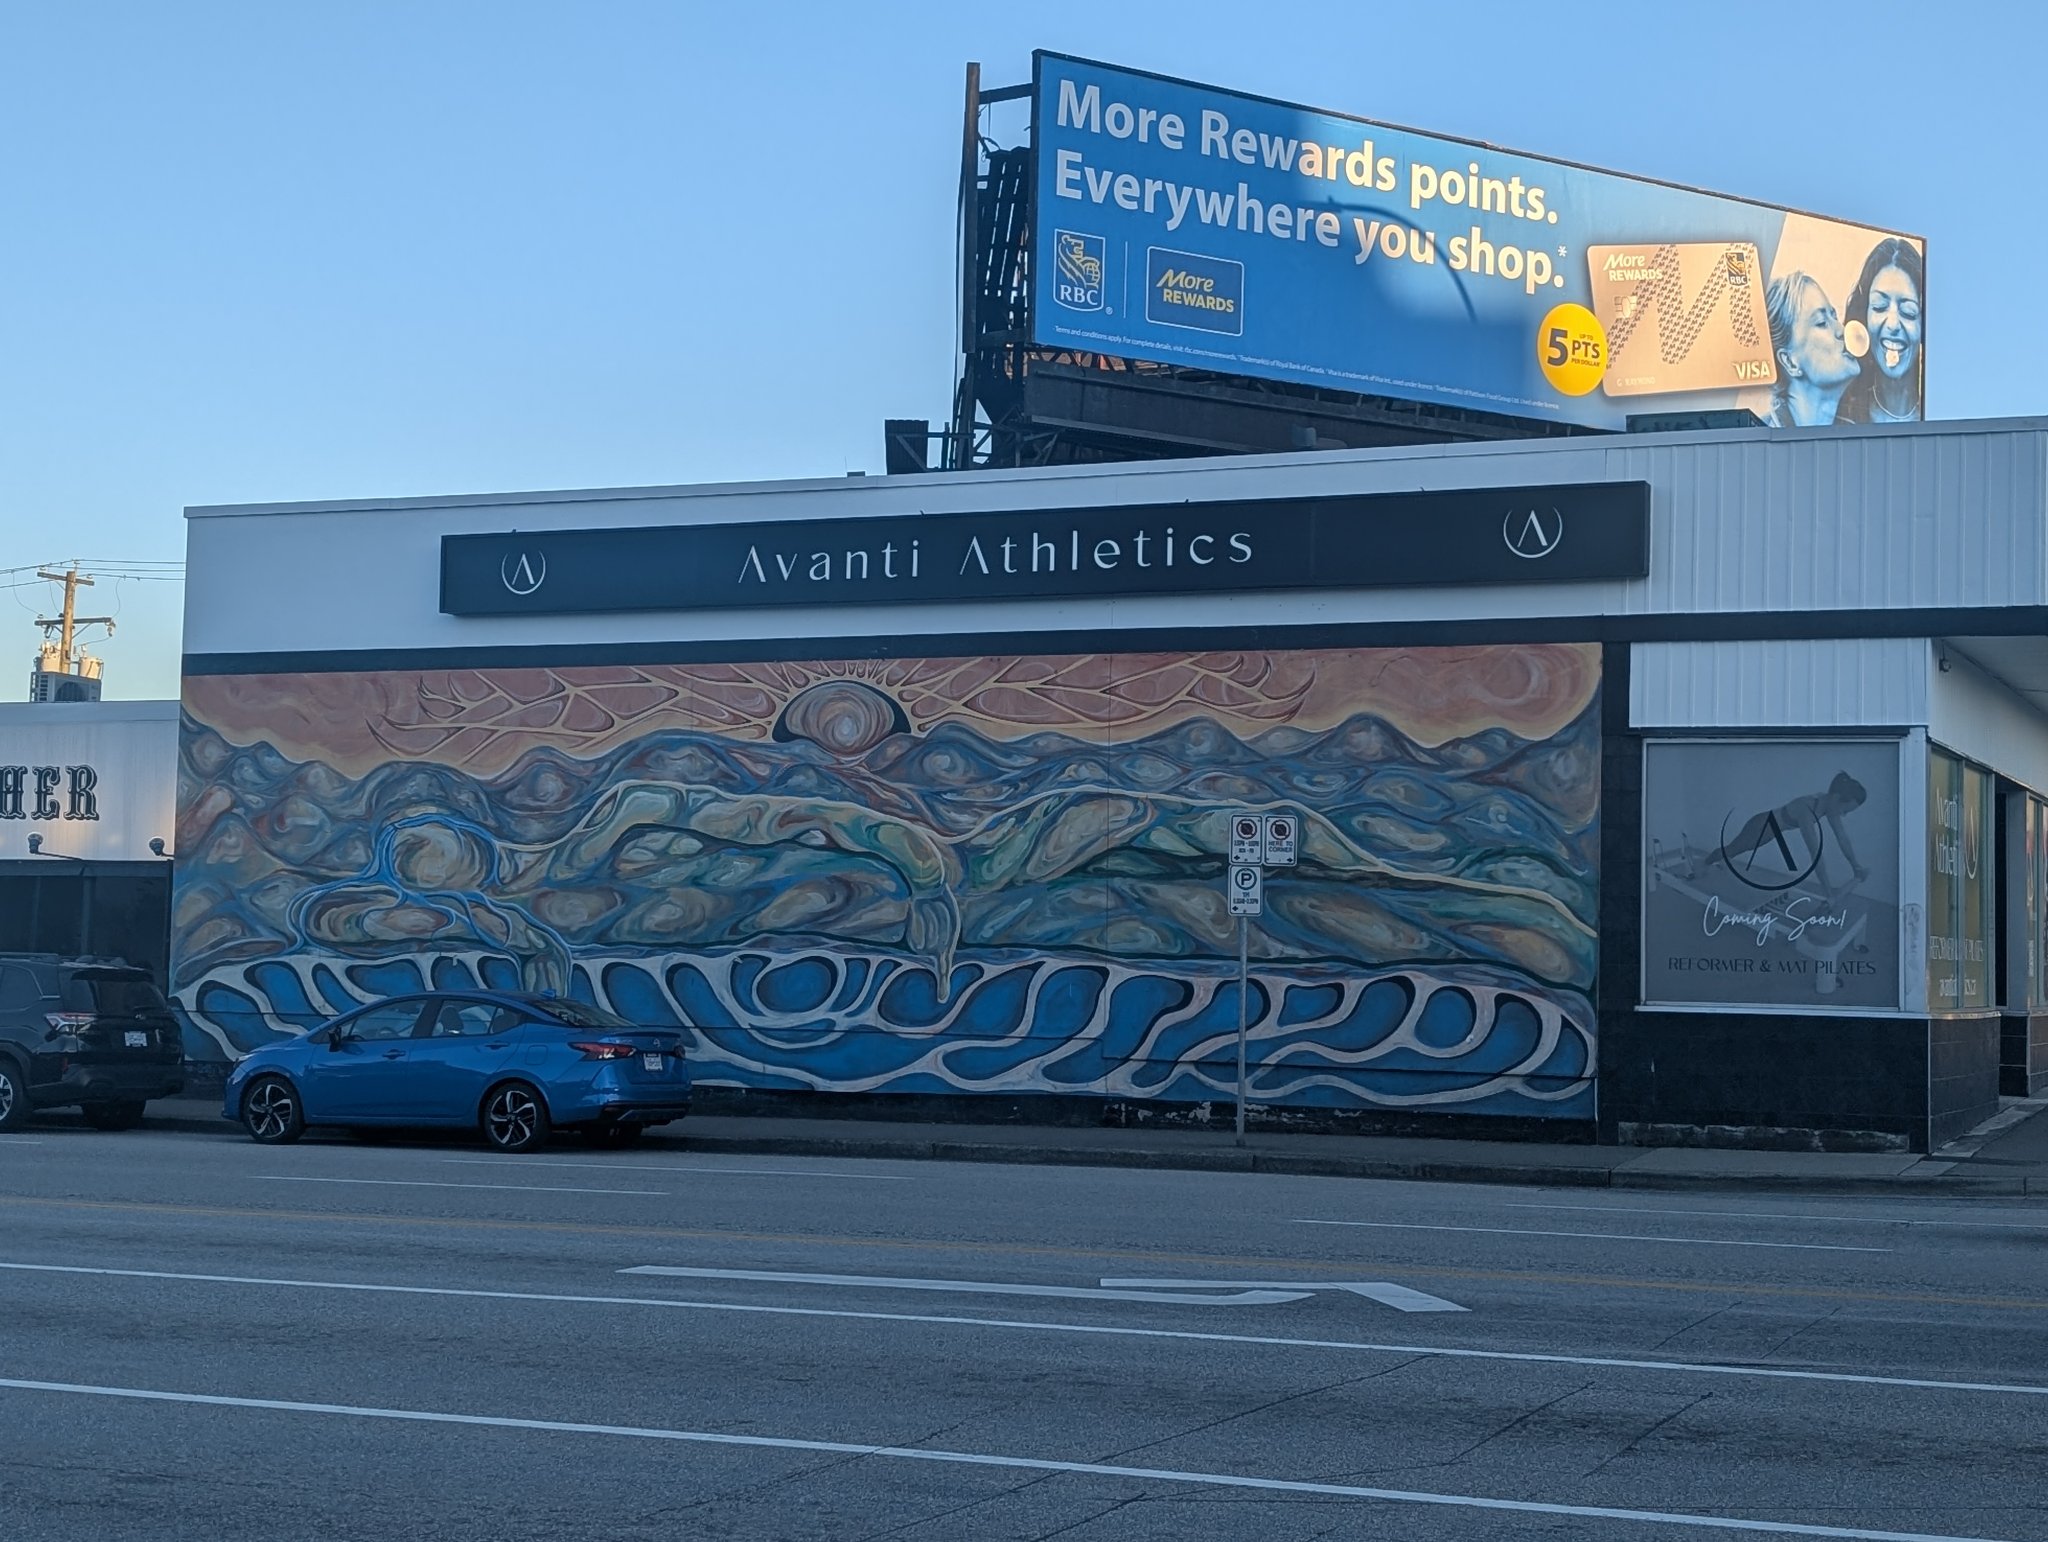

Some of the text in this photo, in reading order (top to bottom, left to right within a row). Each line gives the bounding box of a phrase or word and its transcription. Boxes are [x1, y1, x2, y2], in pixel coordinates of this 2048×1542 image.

[1056, 79, 1558, 225] More Rewards points.
[1055, 149, 1341, 247] Everywhere
[1353, 216, 1435, 266] you
[1603, 253, 1645, 271] More
[1156, 269, 1214, 292] More
[1608, 269, 1663, 281] REWARDS
[1729, 275, 1748, 284] RBC
[1060, 284, 1098, 306] RBC
[1163, 289, 1235, 313] REWARDS
[1547, 328, 1568, 367] 5
[1571, 339, 1601, 359] PTS
[1731, 360, 1771, 380] VISA
[738, 527, 1253, 583] Avanti Athletics
[1241, 873, 1252, 885] P
[1703, 895, 1778, 947] Coming
[1785, 896, 1847, 941] Soon!
[1668, 957, 1876, 975] REFORMER & MAT PILATES
